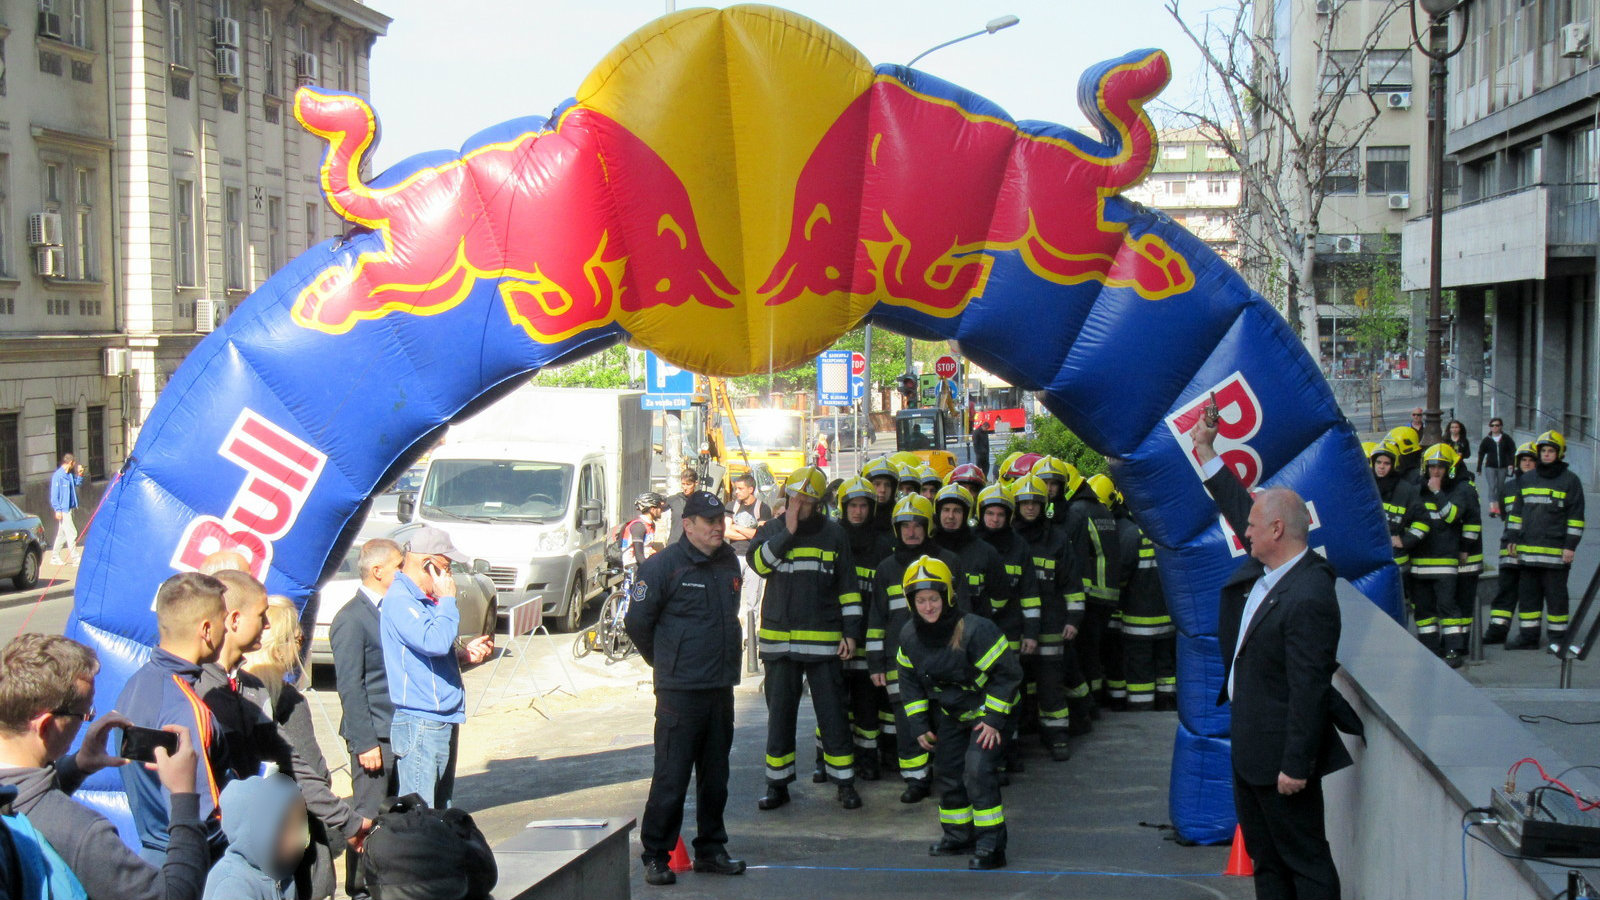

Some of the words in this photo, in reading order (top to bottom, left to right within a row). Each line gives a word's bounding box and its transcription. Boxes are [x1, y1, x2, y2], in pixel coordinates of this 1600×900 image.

[852, 360, 865, 369] TOP
[937, 362, 956, 372] STOP
[174, 411, 324, 584] Bull
